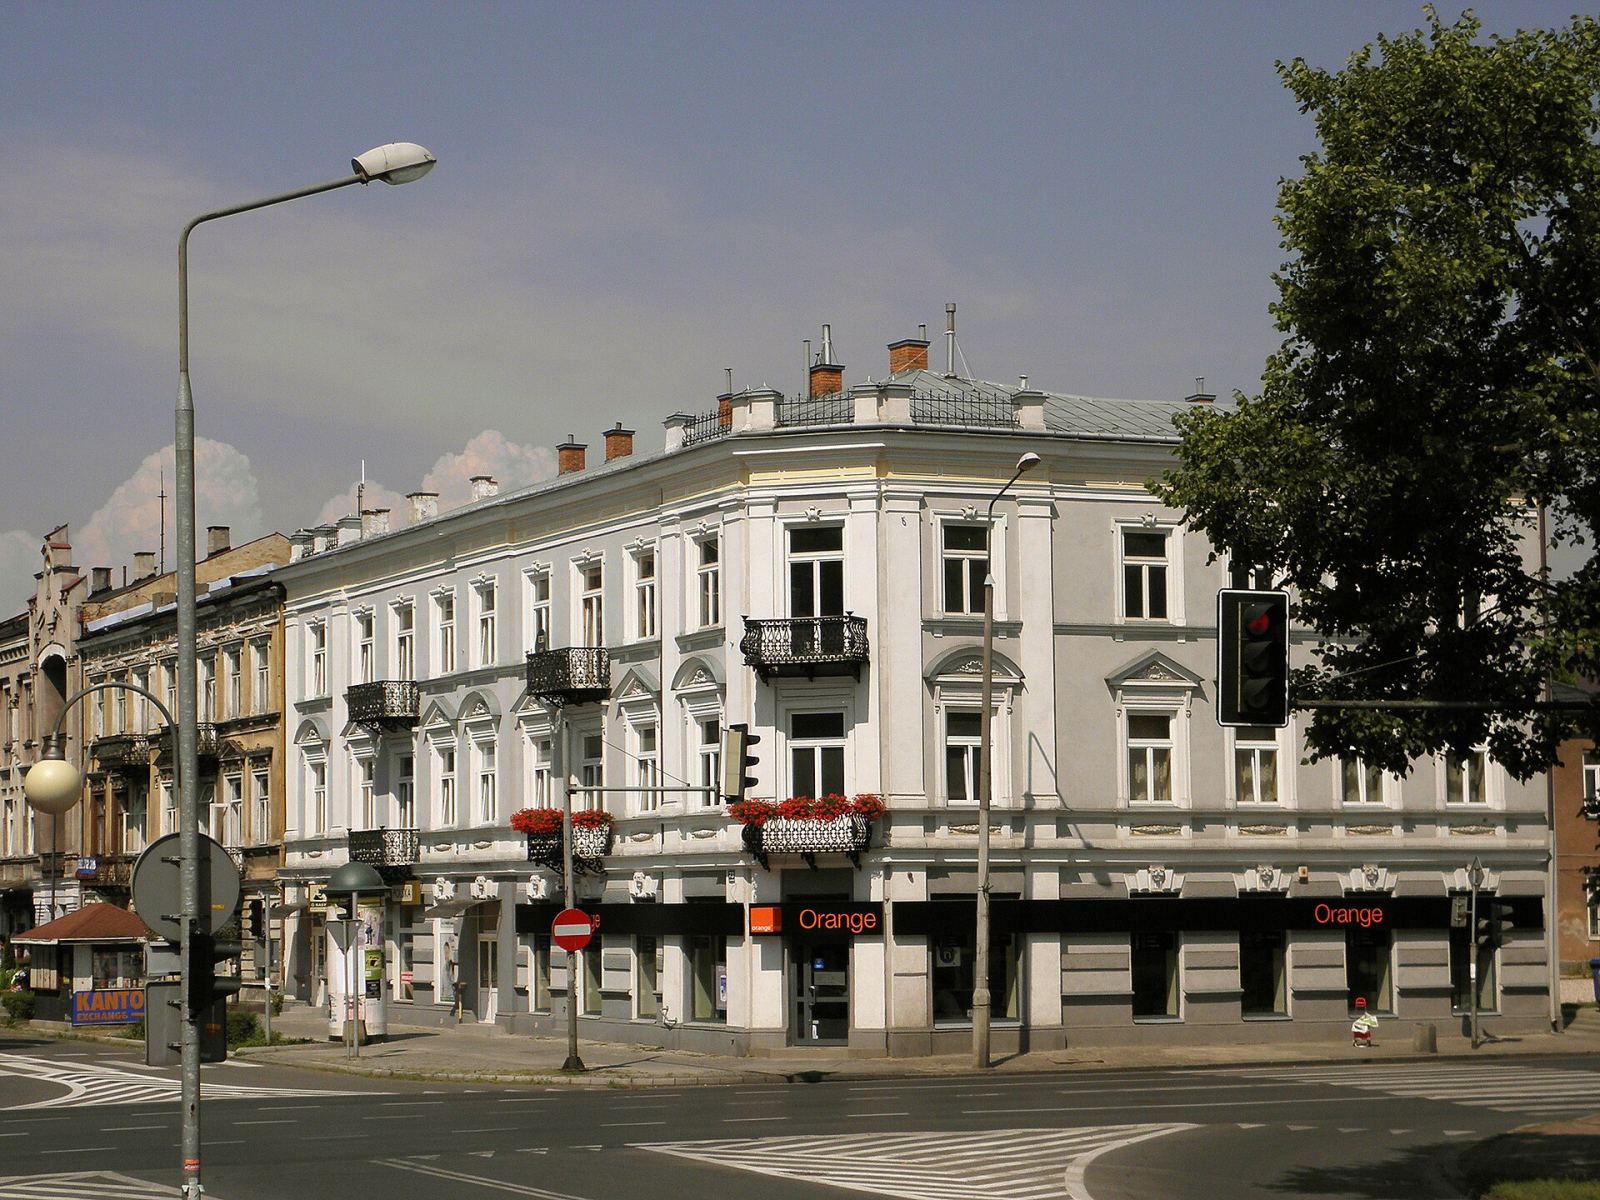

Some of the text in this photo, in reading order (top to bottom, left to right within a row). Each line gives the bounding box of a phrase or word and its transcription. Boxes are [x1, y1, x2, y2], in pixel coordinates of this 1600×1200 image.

[799, 909, 876, 934] Orange
[1315, 903, 1383, 928] Orange
[76, 991, 144, 1012] KANTO
